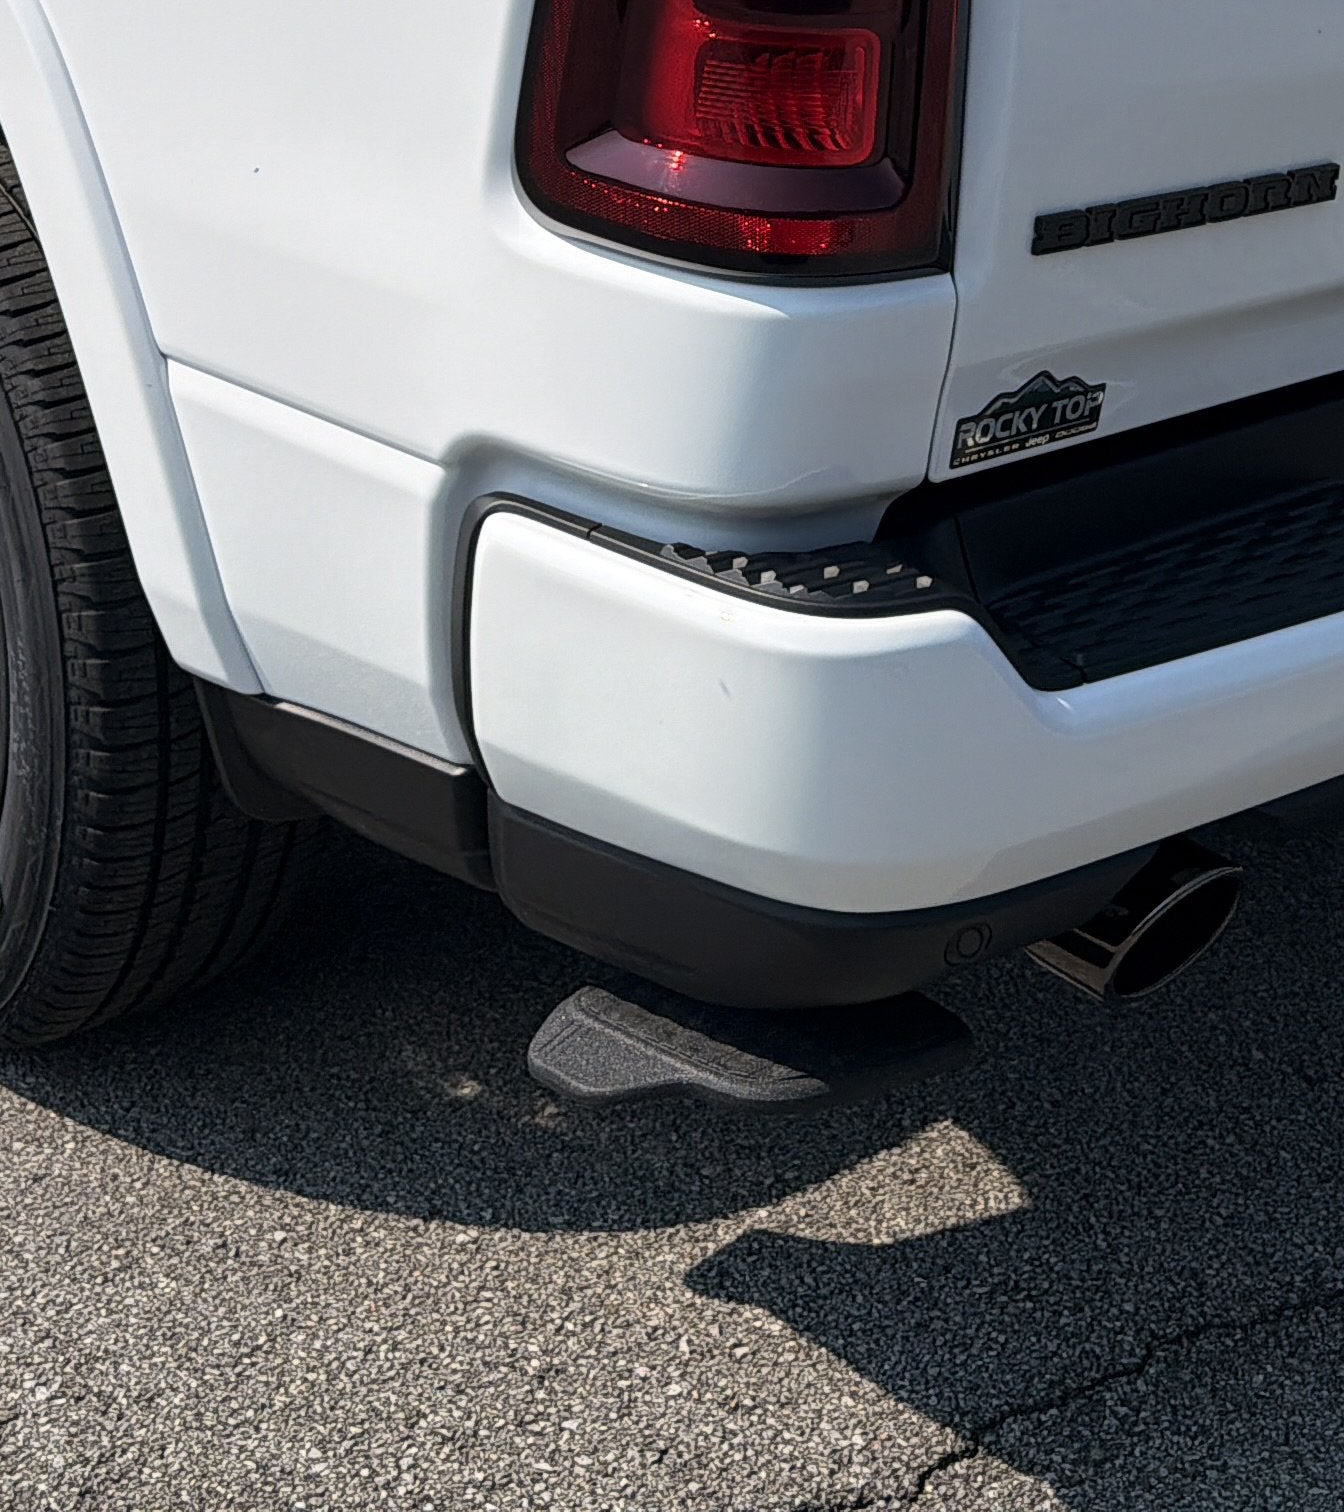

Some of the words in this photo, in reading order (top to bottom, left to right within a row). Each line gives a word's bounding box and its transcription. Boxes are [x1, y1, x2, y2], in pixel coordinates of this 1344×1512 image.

[957, 403, 1048, 449] ROCKY
[1050, 390, 1104, 425] TOP
[953, 442, 1020, 466] CHRYSLER
[1025, 433, 1050, 448] Jeep
